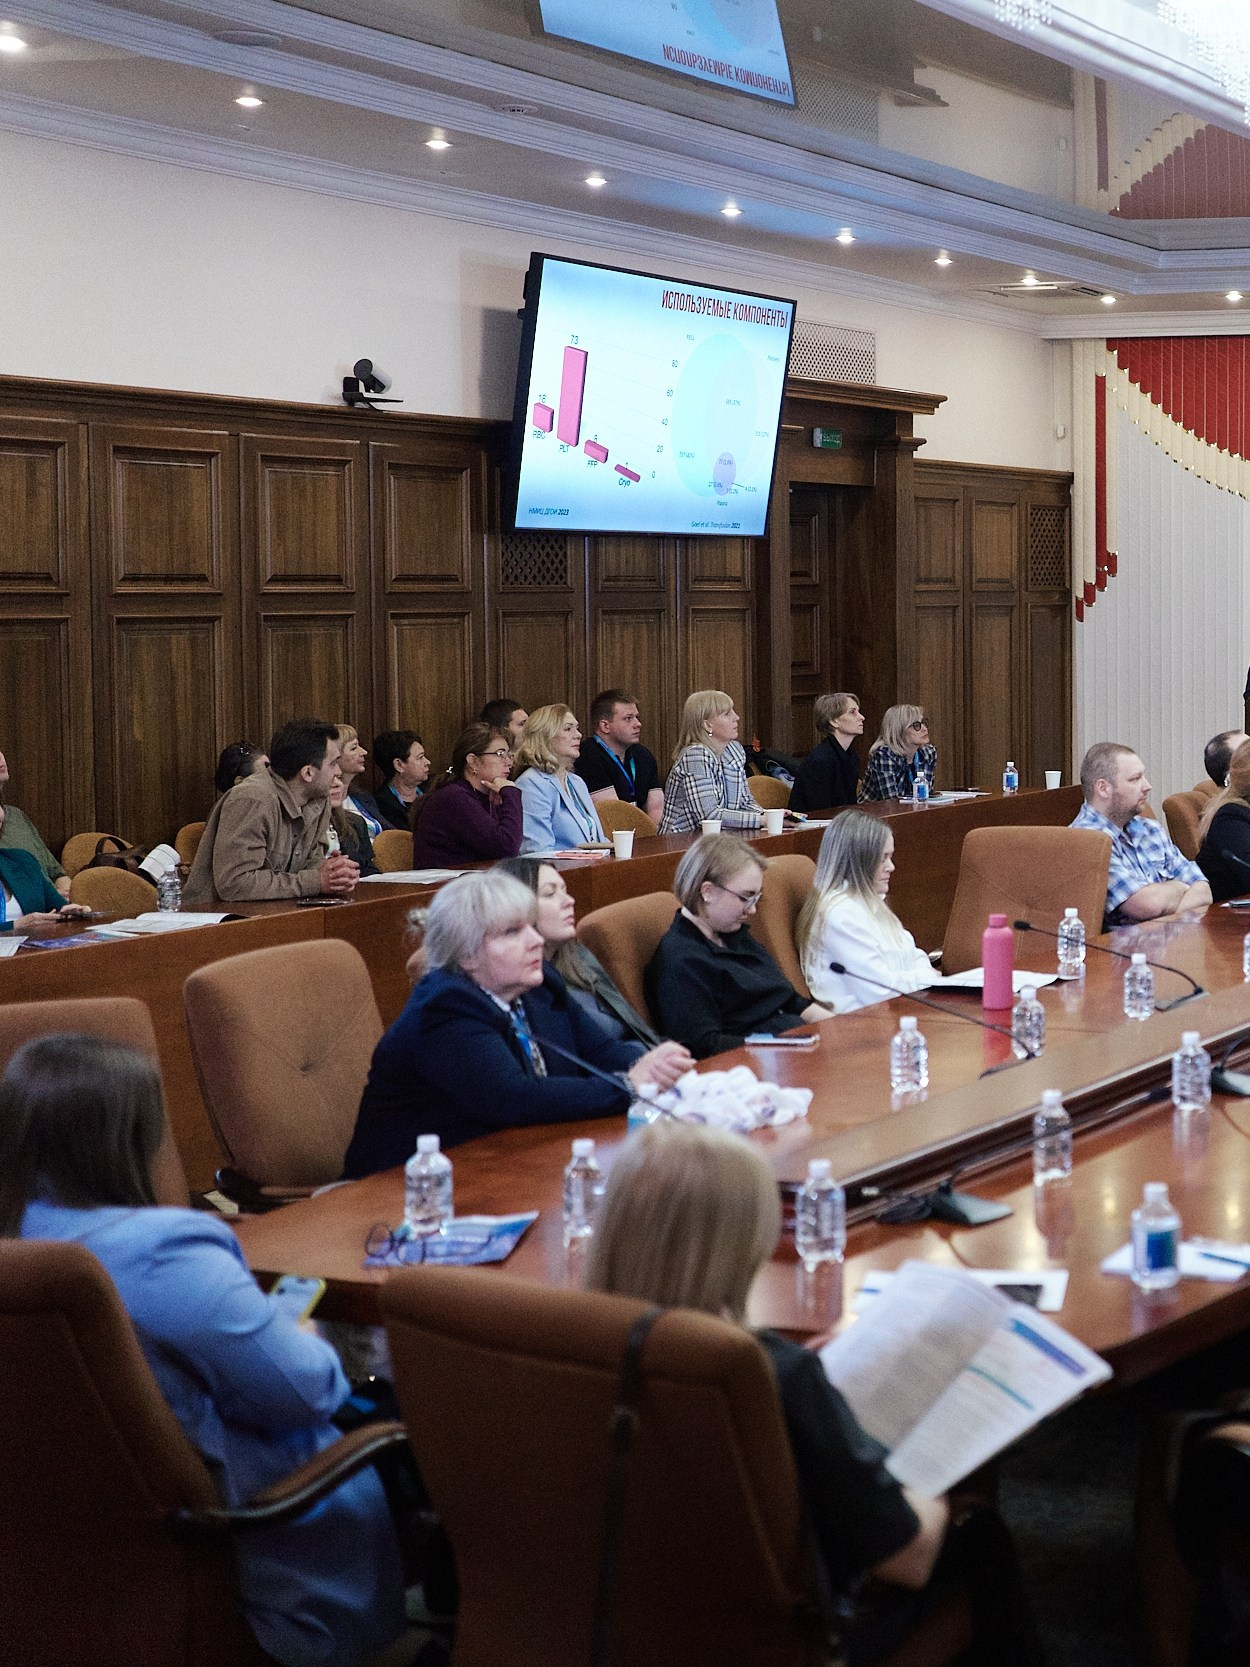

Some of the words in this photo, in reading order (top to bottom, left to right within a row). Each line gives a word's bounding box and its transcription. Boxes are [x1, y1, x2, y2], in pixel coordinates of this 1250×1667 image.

[661, 289, 733, 319] ИСПОЛЬЗУЕМЫЕ
[732, 302, 789, 328] КОМПОНЕНТЫ
[570, 334, 579, 345] 73
[559, 444, 570, 453] PLT
[656, 444, 664, 453] 20
[651, 471, 656, 479] 0
[618, 477, 631, 488] Cryo
